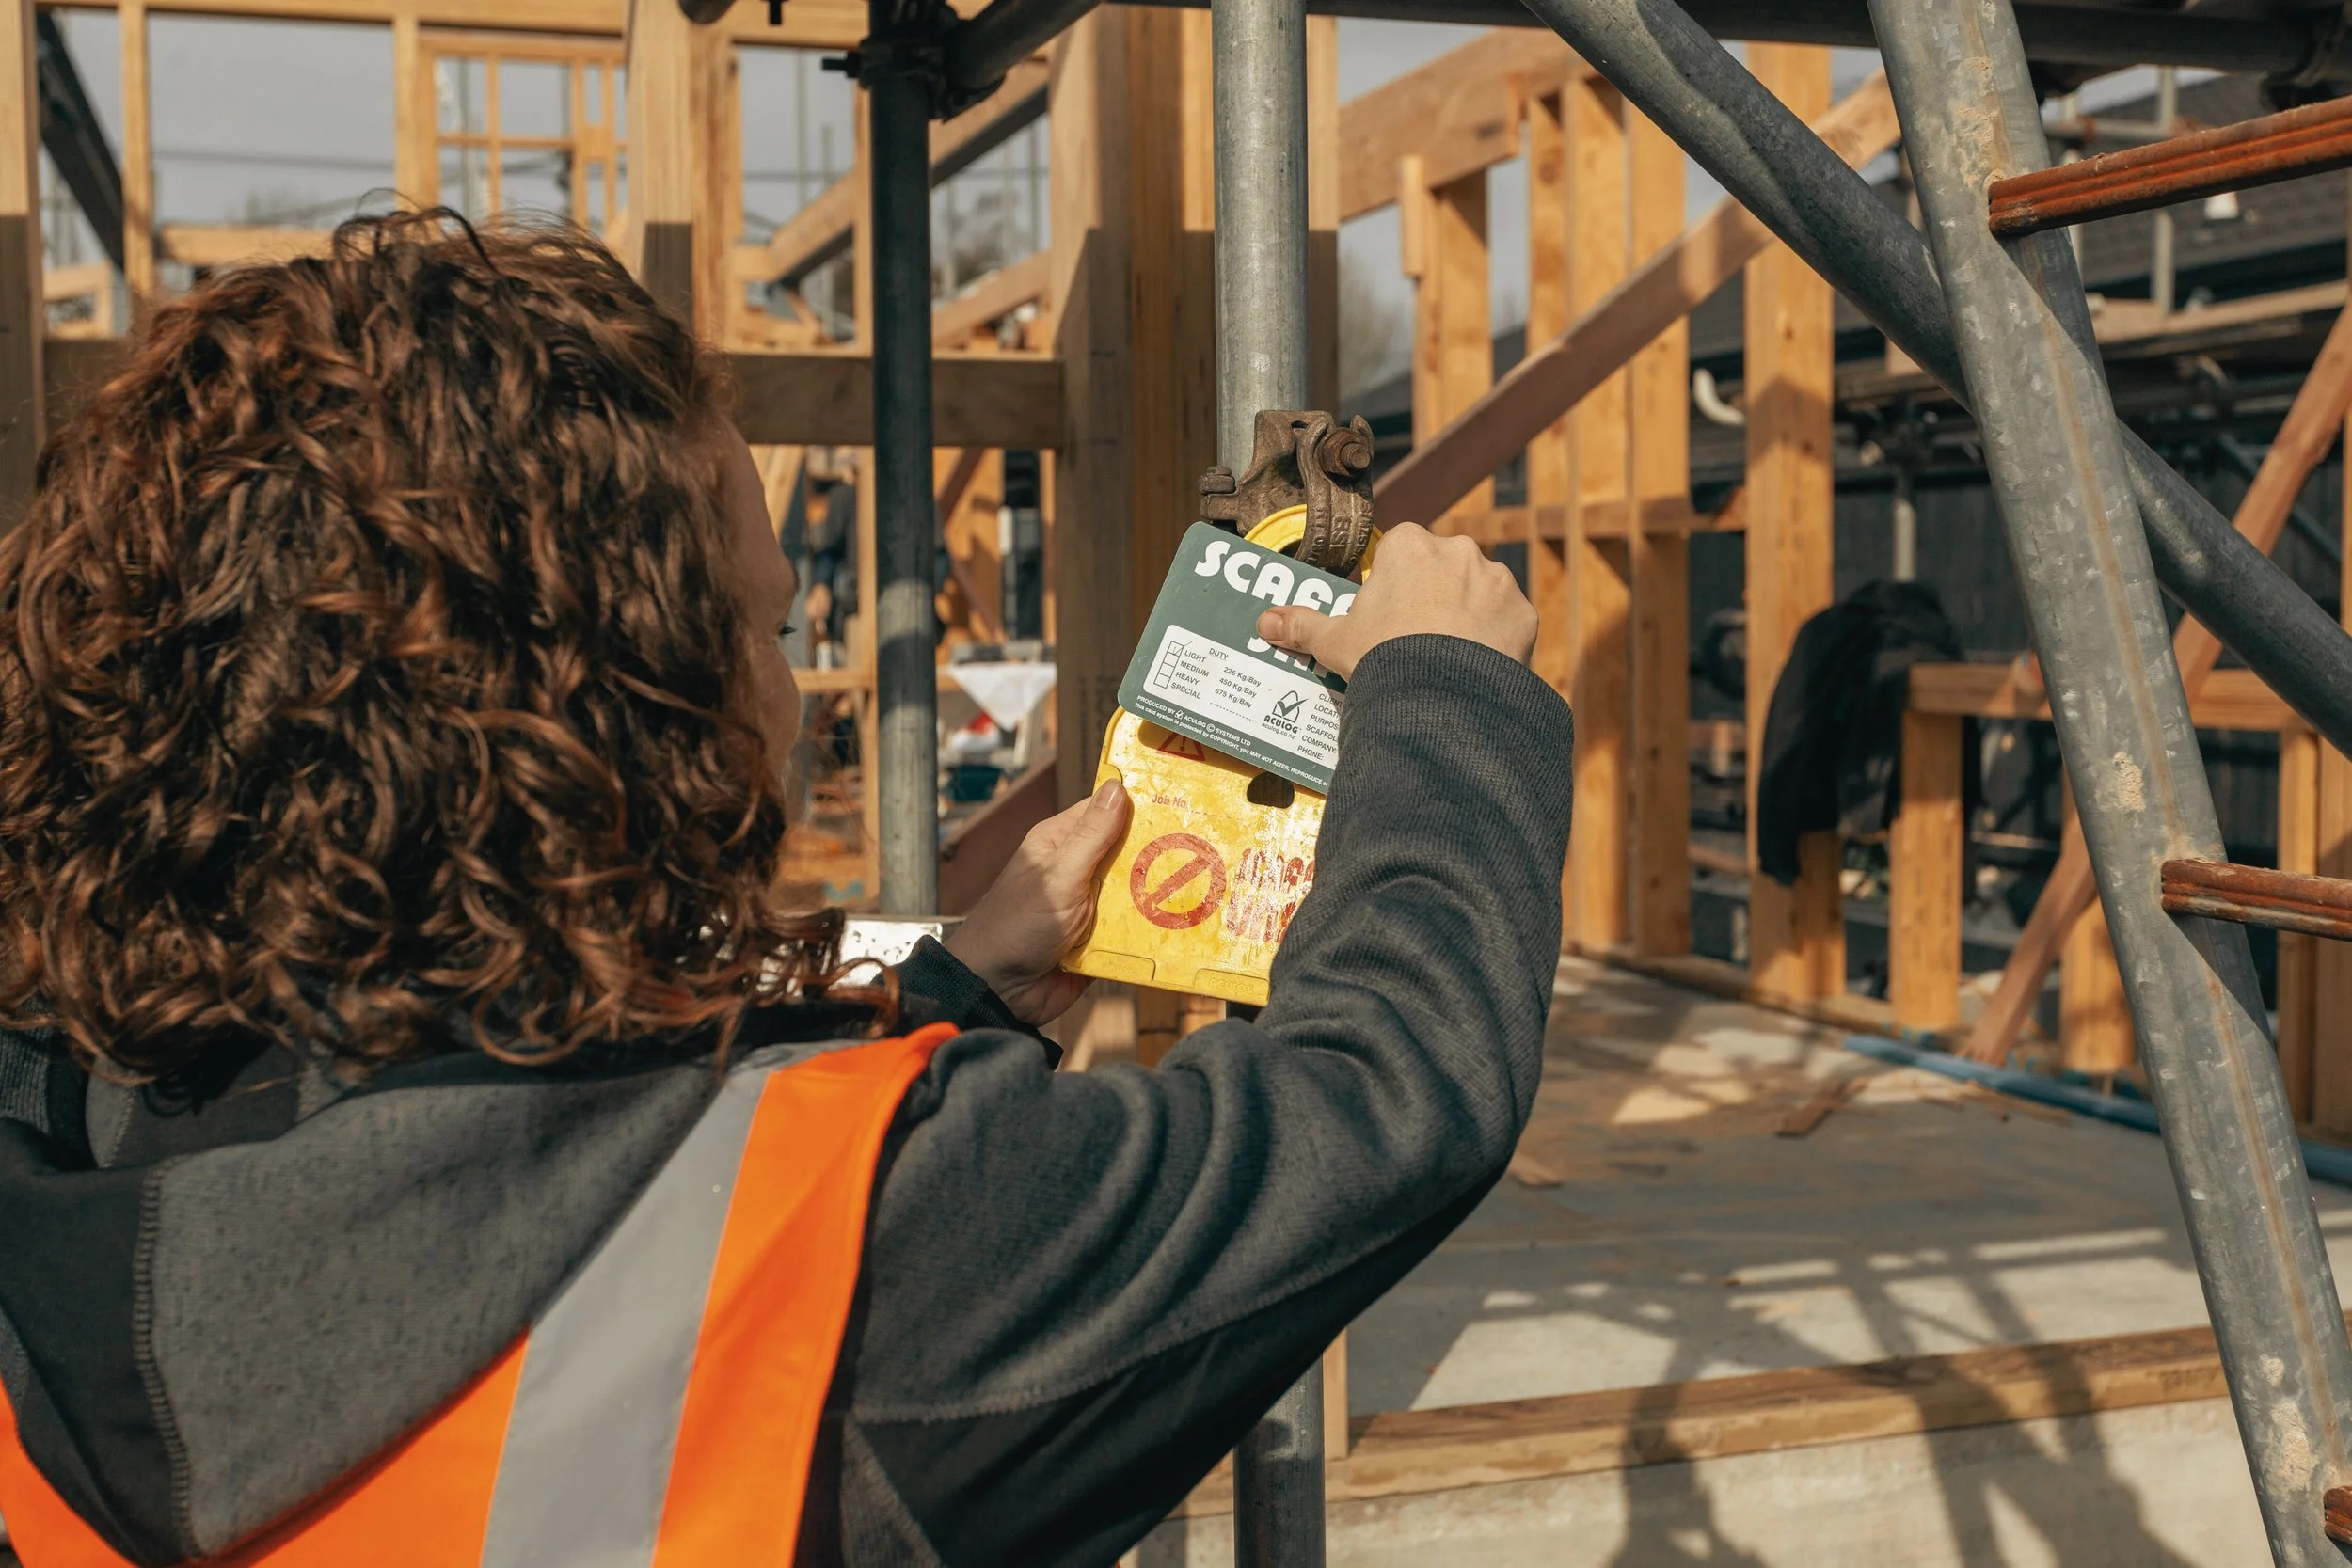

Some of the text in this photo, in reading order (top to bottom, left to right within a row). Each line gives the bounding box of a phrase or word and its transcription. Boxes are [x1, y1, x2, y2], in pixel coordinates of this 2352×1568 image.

[1208, 647, 1229, 660] DUTY
[1184, 649, 1262, 688] LIGHT 225 Kg/Bay
[1180, 660, 1257, 699] MEDIUM 450 Kg/Bay
[1170, 682, 1200, 700] SPECIAL
[1175, 671, 1253, 709] HEAVY 675 Kg/Bay
[1136, 694, 1168, 712] PRODUCED
[1183, 715, 1207, 728] ACULOG
[1215, 727, 1241, 742] SYSTEMS
[1240, 737, 1251, 747] LTD
[1263, 714, 1299, 735] ACULOG
[1310, 713, 1340, 731] PURPOS
[1135, 702, 1145, 711] This
[1144, 707, 1157, 716] card
[1156, 712, 1174, 722] system
[1178, 721, 1203, 735] protected
[1201, 730, 1210, 738] by
[1209, 733, 1240, 751] COPYRIGHT,
[1249, 750, 1262, 759] MAY
[1261, 755, 1273, 764] NOT
[1272, 760, 1290, 772] ALTER,
[1290, 767, 1323, 784] REPRODUCE
[1305, 724, 1339, 742] SCAFFOL
[1301, 735, 1338, 754] COMPANY:
[1152, 793, 1170, 806] Job
